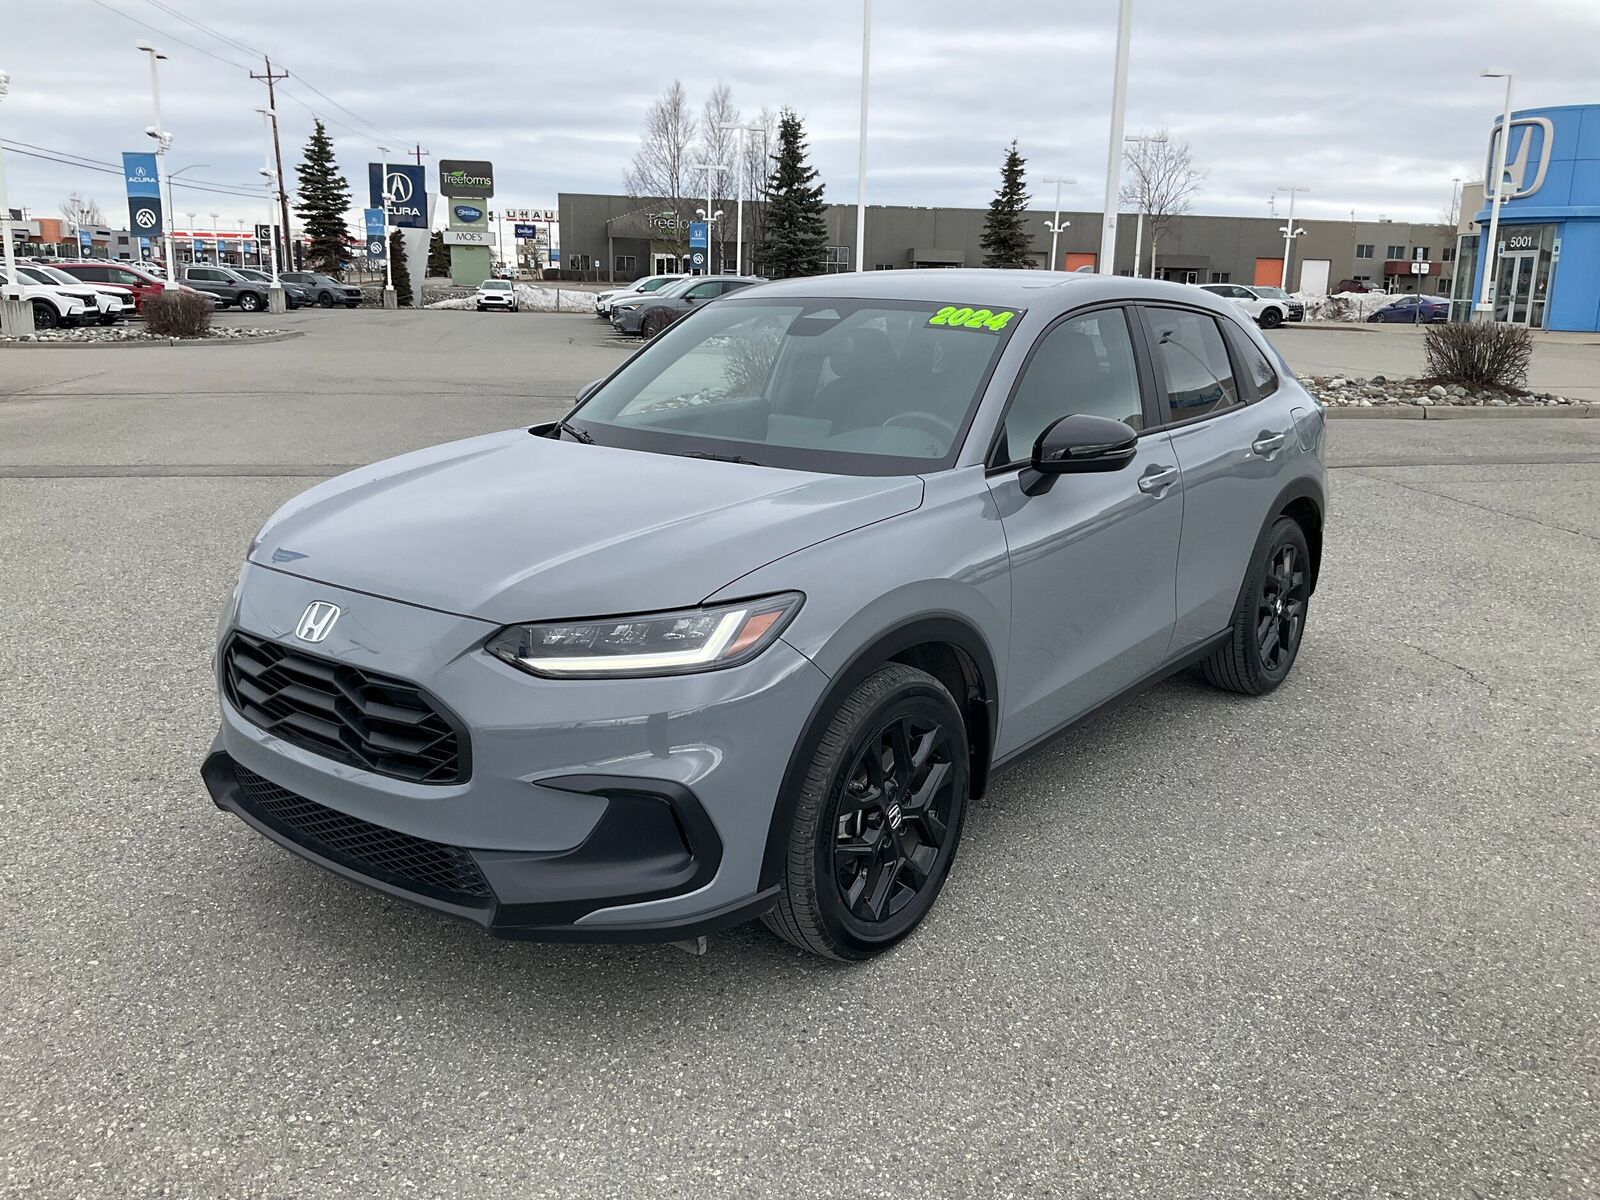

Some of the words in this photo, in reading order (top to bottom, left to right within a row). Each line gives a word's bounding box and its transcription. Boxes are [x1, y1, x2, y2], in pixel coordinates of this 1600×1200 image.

[441, 172, 492, 185] Treeforms
[456, 232, 483, 241] MOE'S
[1510, 236, 1532, 248] 5001
[928, 306, 1015, 331] 2024
